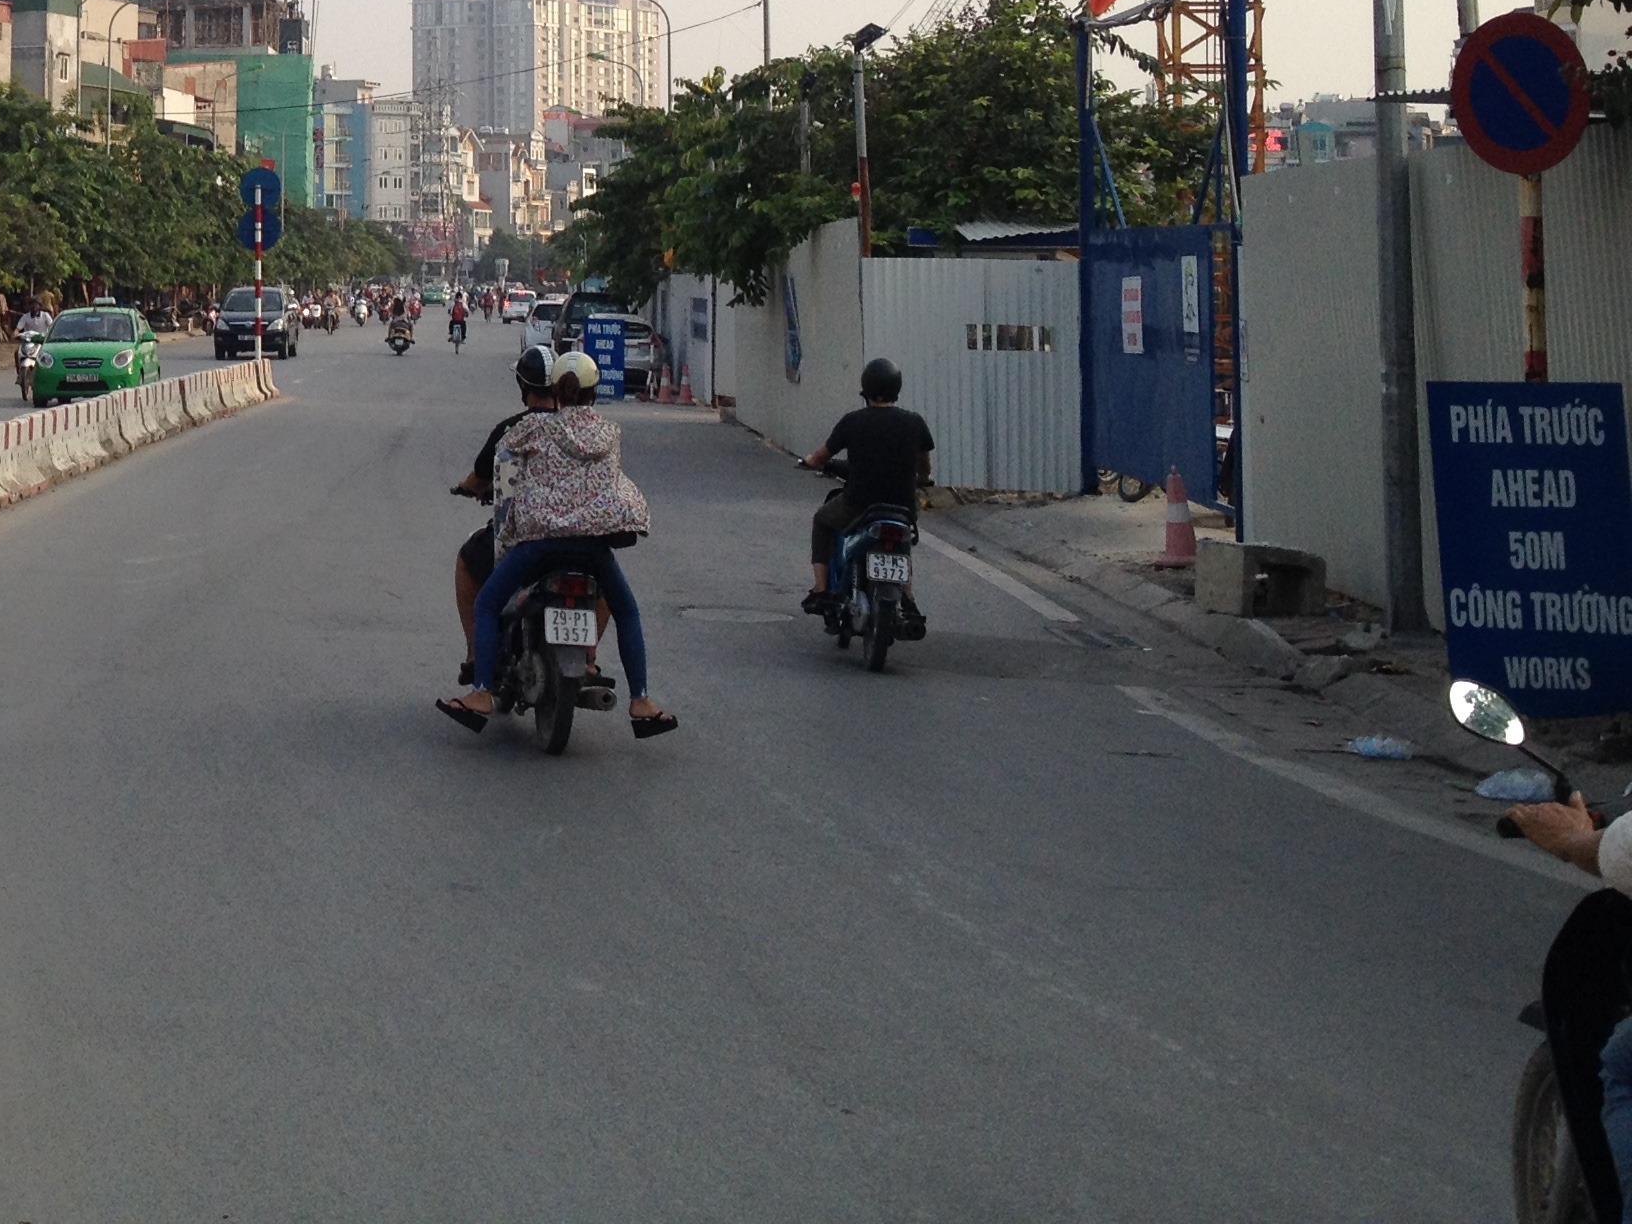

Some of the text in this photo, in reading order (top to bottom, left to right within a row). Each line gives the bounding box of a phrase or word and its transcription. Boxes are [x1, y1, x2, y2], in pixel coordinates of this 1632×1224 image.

[588, 323, 601, 335] PHÍA
[1449, 398, 1605, 446] PHÍA TRƯỚC
[1491, 469, 1577, 508] AHEAD
[1508, 531, 1566, 570] 50M
[874, 566, 904, 581] 9372
[1449, 583, 1632, 636] CÔNG TRƯỜNG
[553, 626, 589, 643] 1357
[1504, 656, 1591, 691] WORKS
